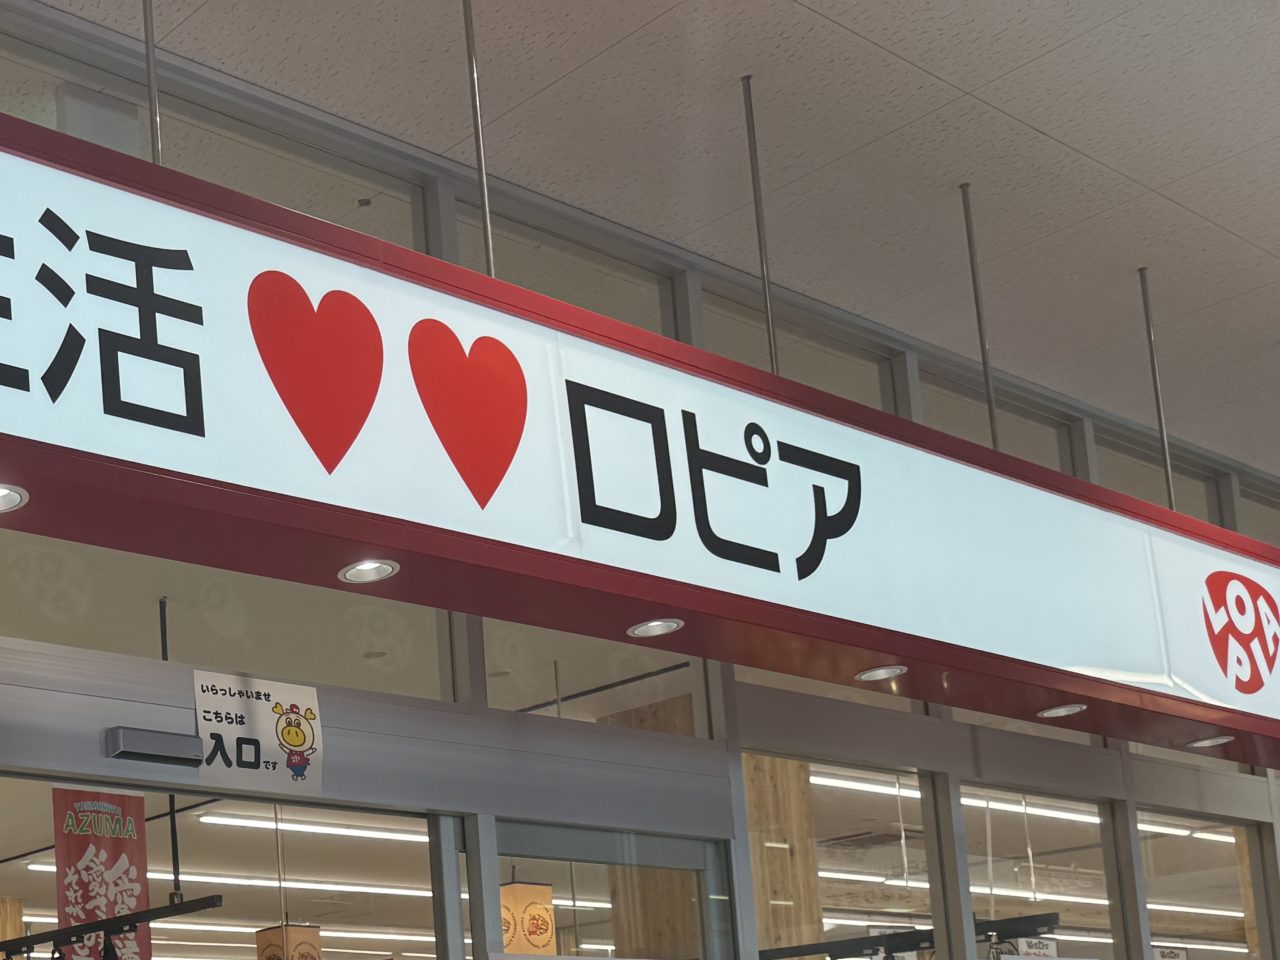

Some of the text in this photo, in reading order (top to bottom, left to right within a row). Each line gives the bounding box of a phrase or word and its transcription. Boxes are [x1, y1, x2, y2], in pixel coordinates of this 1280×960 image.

[565, 379, 861, 581] ロピア
[201, 684, 271, 701] いらっしゃいませ
[203, 709, 246, 725] こちらは
[63, 811, 136, 839] AZUMA
